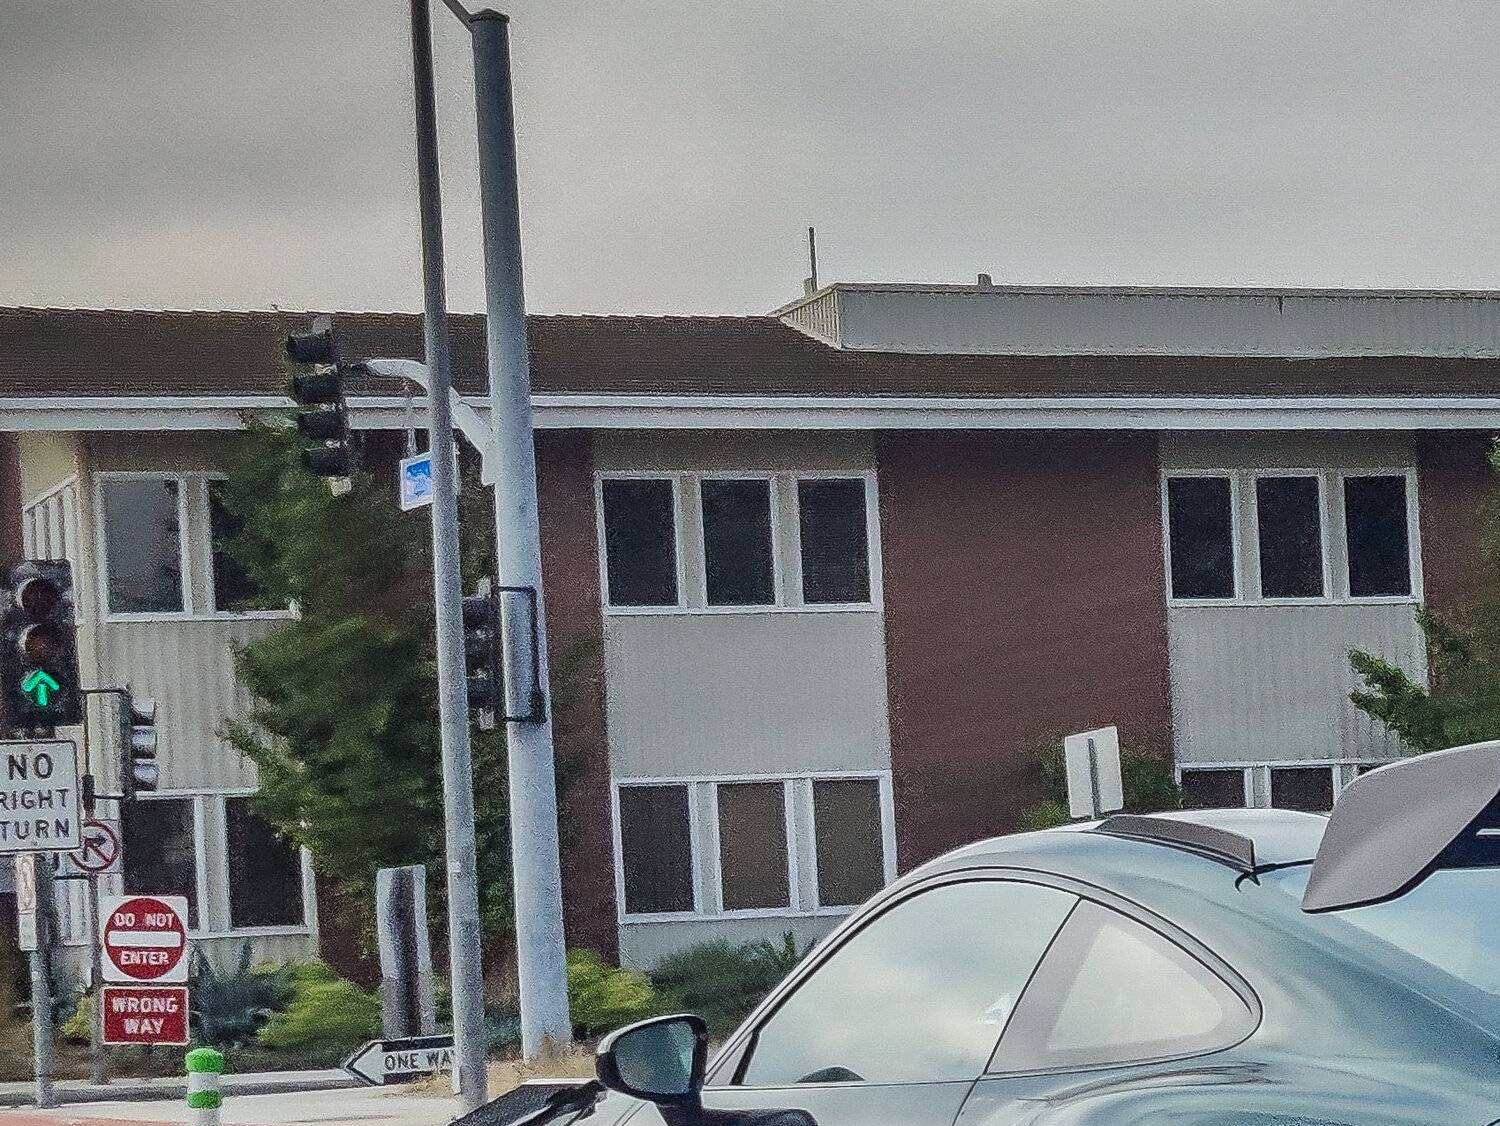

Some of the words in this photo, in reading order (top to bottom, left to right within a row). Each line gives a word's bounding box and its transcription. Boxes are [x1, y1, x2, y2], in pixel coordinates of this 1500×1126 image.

[8, 752, 53, 780] NO
[0, 818, 70, 841] TURN
[113, 912, 134, 928] DO
[145, 911, 176, 928] NOT
[119, 949, 169, 966] ENTER
[111, 996, 179, 1014] WRONG
[123, 1018, 164, 1036] WAY
[384, 1053, 420, 1071] ONE
[426, 1049, 454, 1069] WA
